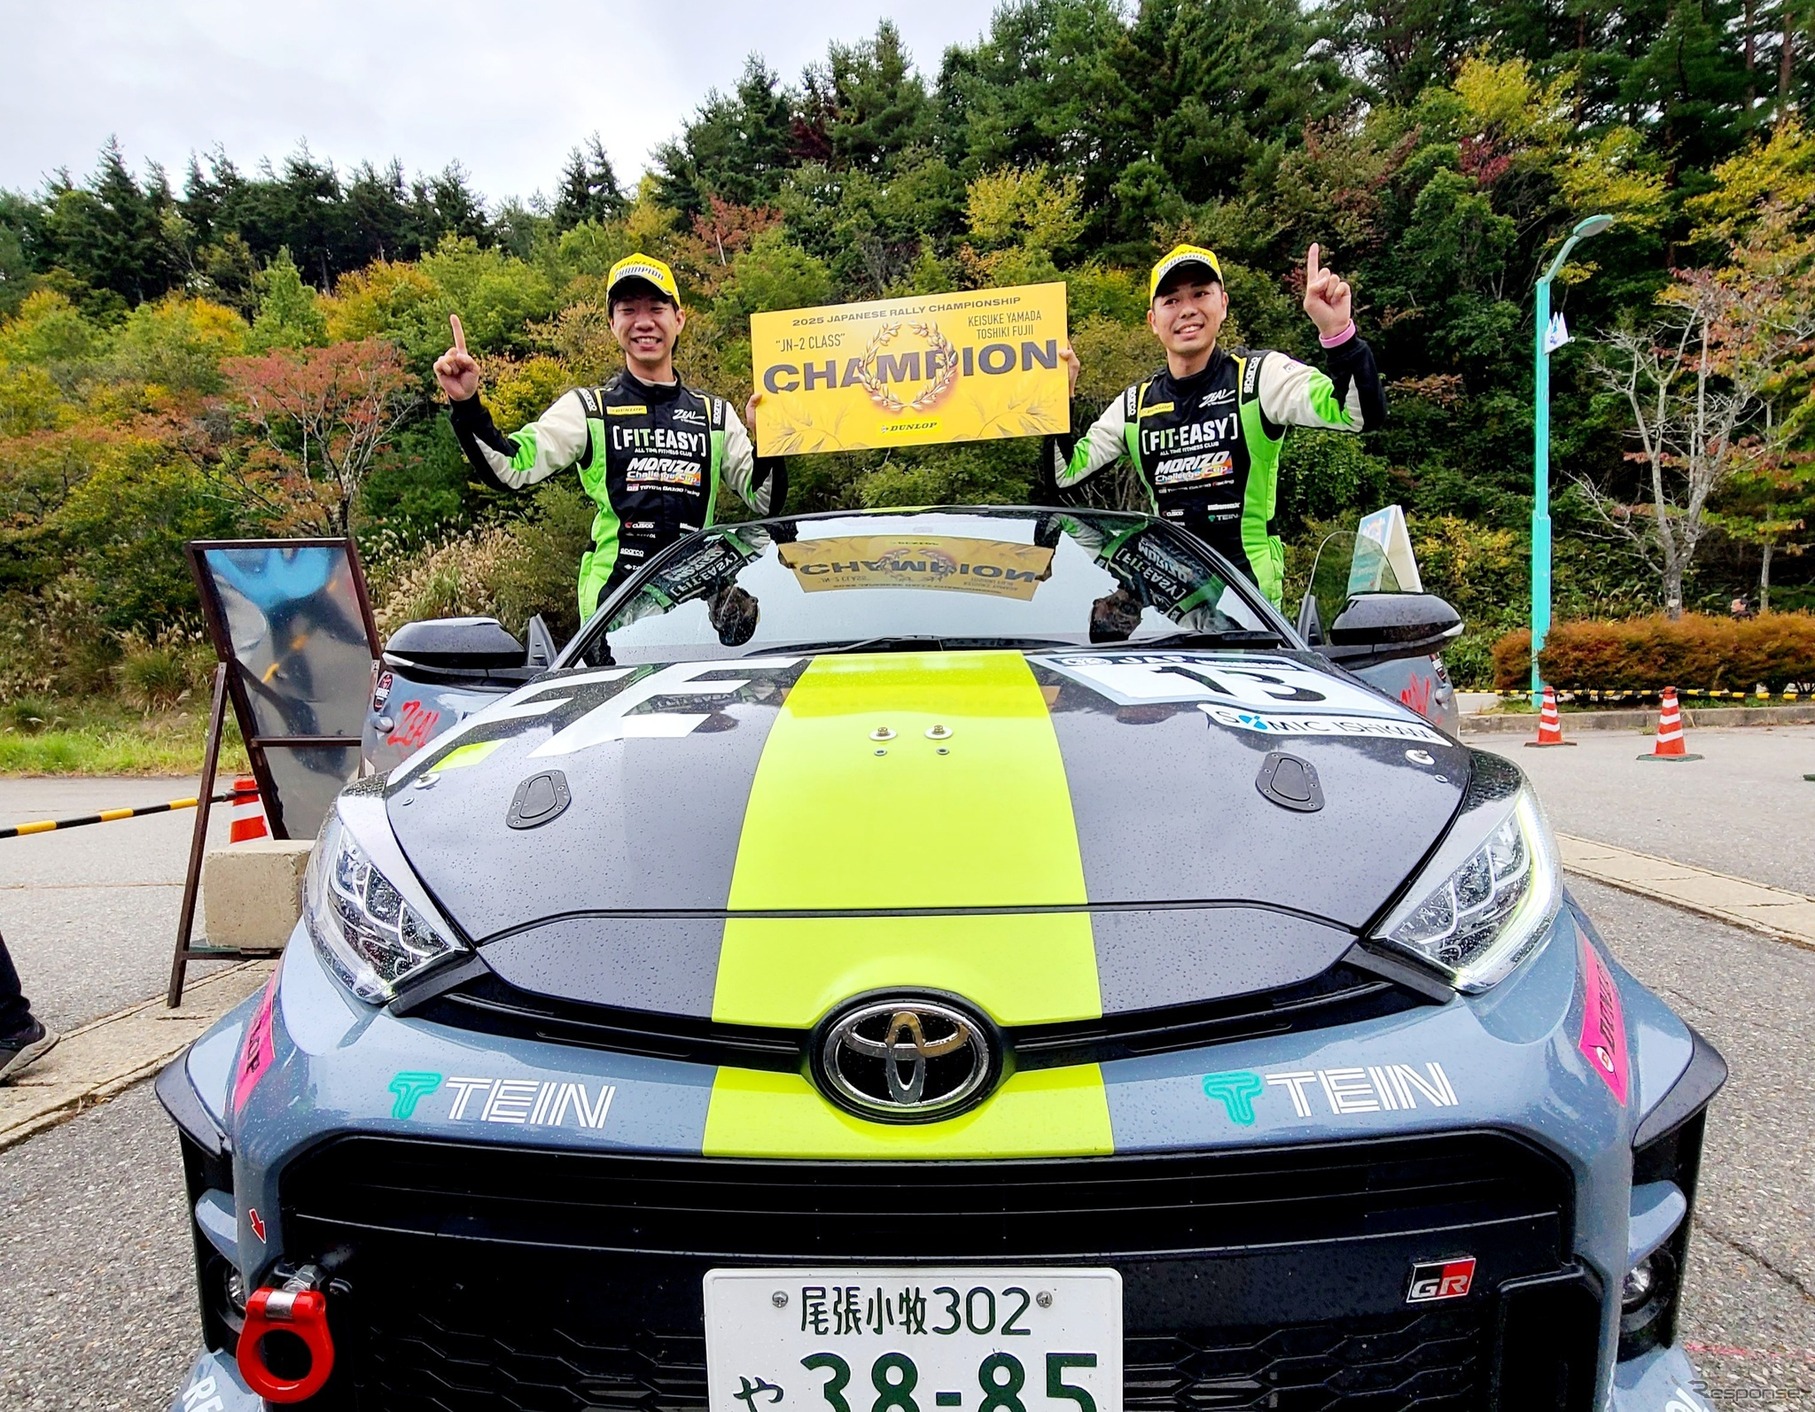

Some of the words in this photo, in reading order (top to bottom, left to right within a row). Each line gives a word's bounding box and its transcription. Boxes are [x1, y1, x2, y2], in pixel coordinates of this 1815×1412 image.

[792, 316, 824, 327] 2025
[827, 310, 887, 323] JAPANESE
[889, 305, 926, 317] RALLY
[928, 296, 1021, 312] CHAMPIONSHIP
[968, 313, 1004, 327] KEISUKE
[1006, 310, 1042, 323] YAMADA
[976, 326, 1010, 340] TOSHIKI
[1012, 324, 1034, 337] FUJII
[763, 339, 1058, 395] CHAMPION
[890, 421, 938, 432] DUNLOP
[1182, 444, 1204, 453] FITNESS
[627, 457, 701, 474] MORIZO
[1154, 450, 1230, 475] MORIZO
[1266, 1061, 1461, 1118] TEIN
[445, 1075, 617, 1129] TEIN
[1411, 1275, 1469, 1298] GR
[799, 1351, 1098, 1412] 38-85
